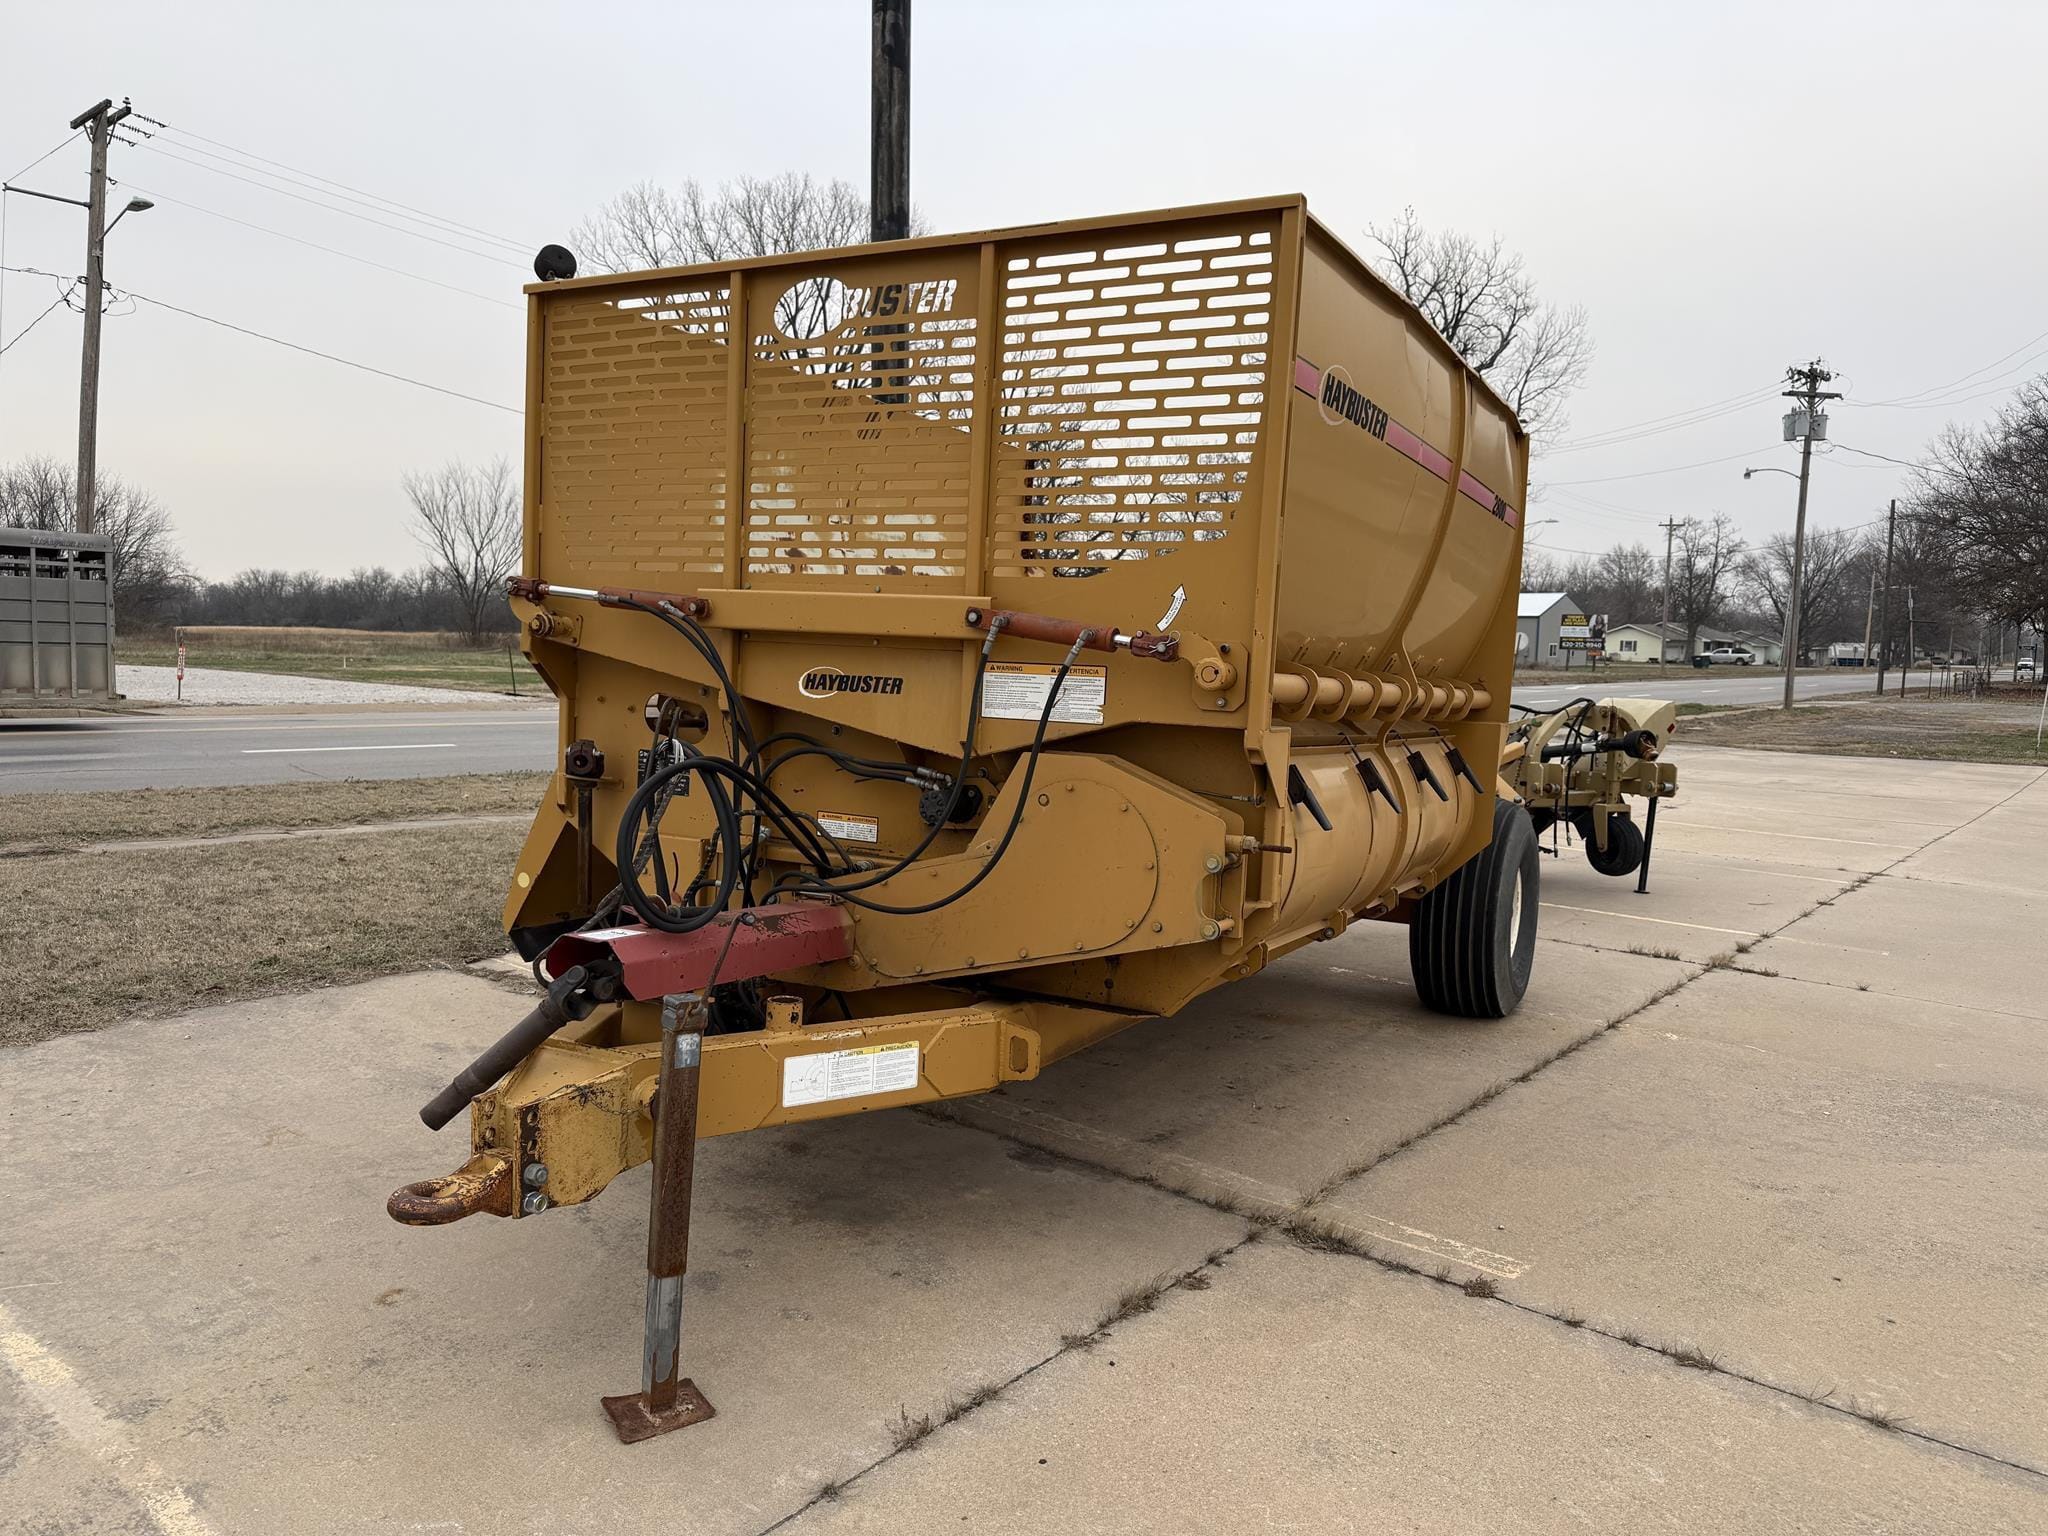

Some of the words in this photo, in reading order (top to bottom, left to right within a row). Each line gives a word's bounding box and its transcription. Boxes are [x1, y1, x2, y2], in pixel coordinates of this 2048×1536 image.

[1322, 373, 1388, 441] HAYBUSTER
[996, 664, 1023, 672] WARNING
[1057, 666, 1099, 675] AERTENCIA
[804, 673, 904, 695] HAYBUSTER
